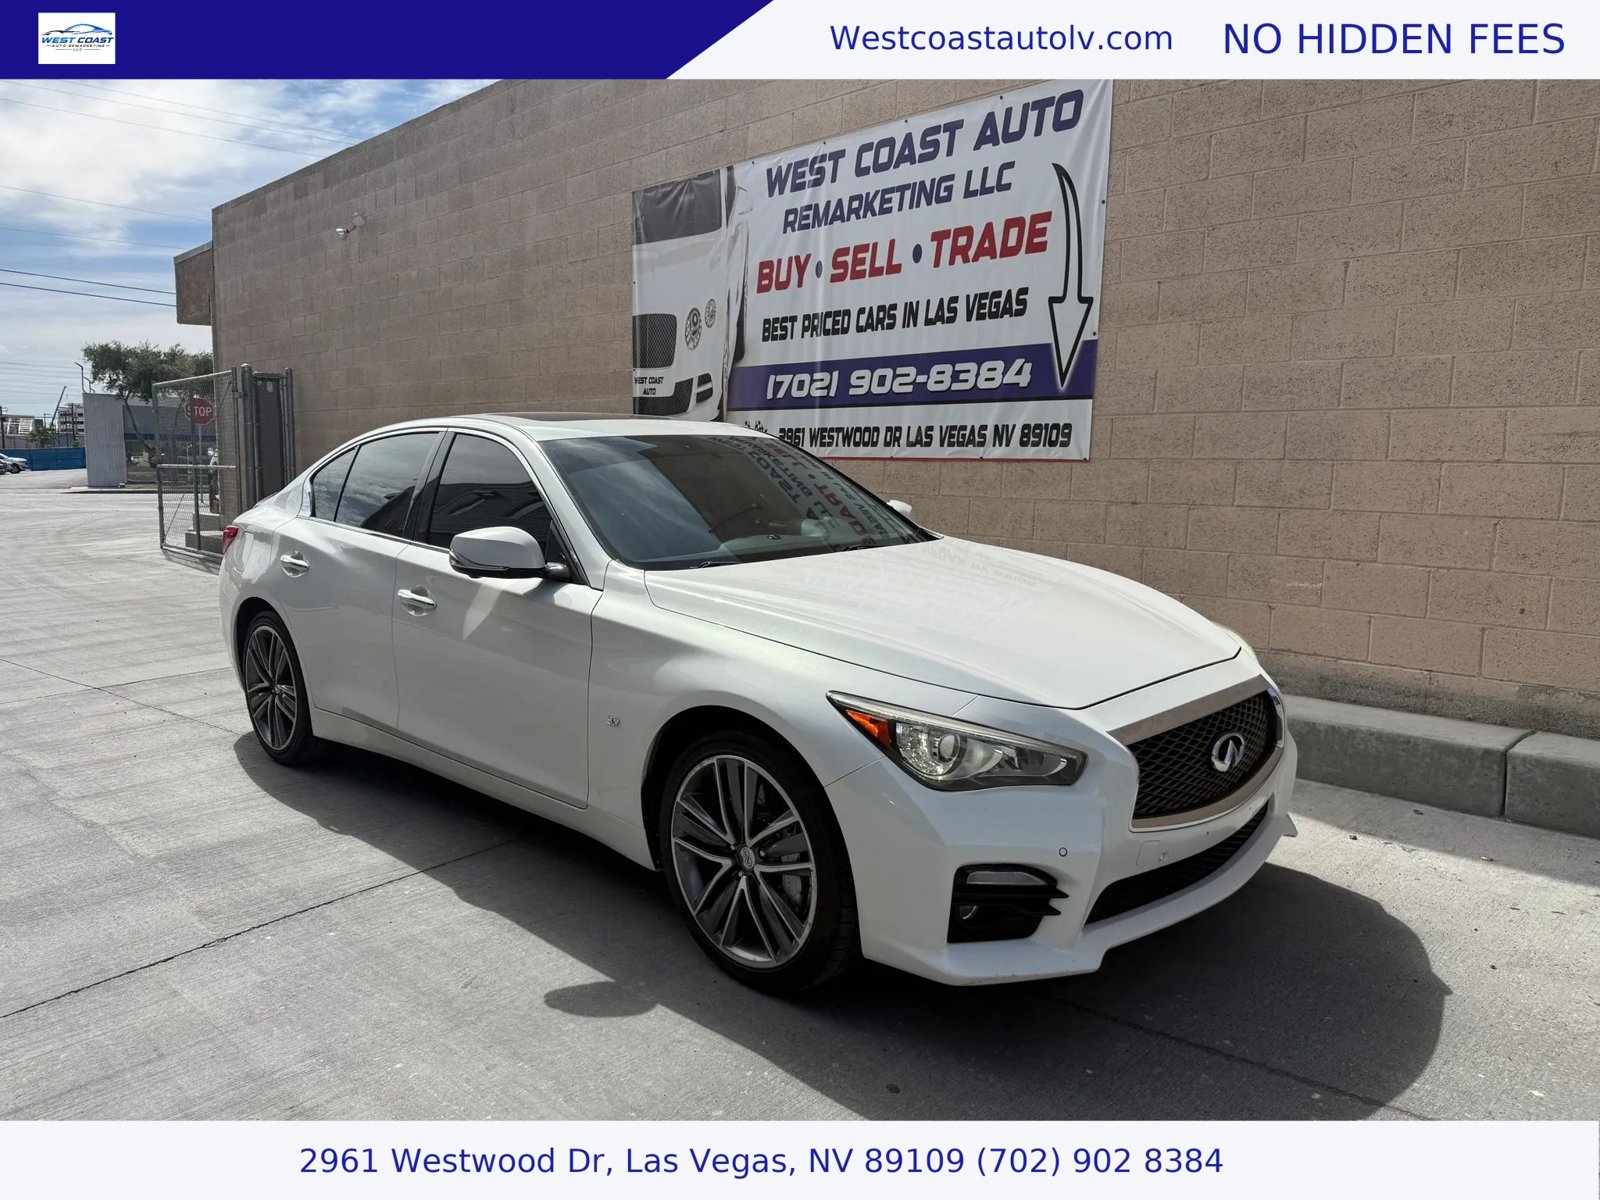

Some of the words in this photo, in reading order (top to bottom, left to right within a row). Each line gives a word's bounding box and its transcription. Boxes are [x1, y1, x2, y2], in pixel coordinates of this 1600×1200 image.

[766, 149, 846, 198] WEST
[855, 119, 964, 178] COAST
[973, 89, 1084, 151] AUTO
[783, 173, 955, 234] REMARKETING
[963, 161, 1015, 199] LLC
[756, 253, 811, 293] BUY
[830, 239, 902, 283] SELL
[931, 211, 1052, 268] TRADE
[762, 315, 798, 342] BEST
[801, 309, 850, 339] PRICED
[856, 303, 898, 333] CARS
[902, 300, 919, 328] IN
[924, 296, 959, 326] LAS
[966, 287, 1029, 321] VEGAS
[634, 376, 648, 384] WEST
[648, 376, 664, 384] COAST
[767, 370, 839, 399] (702)
[848, 358, 1032, 396] 902-8384
[186, 406, 212, 416] STOP
[779, 427, 805, 447] 2961
[808, 426, 880, 448] WESTWOOD
[883, 426, 900, 448] DR
[906, 425, 934, 448] LAS
[939, 424, 988, 448] VEGAS
[992, 424, 1016, 448] NV
[1019, 422, 1073, 448] 89109
